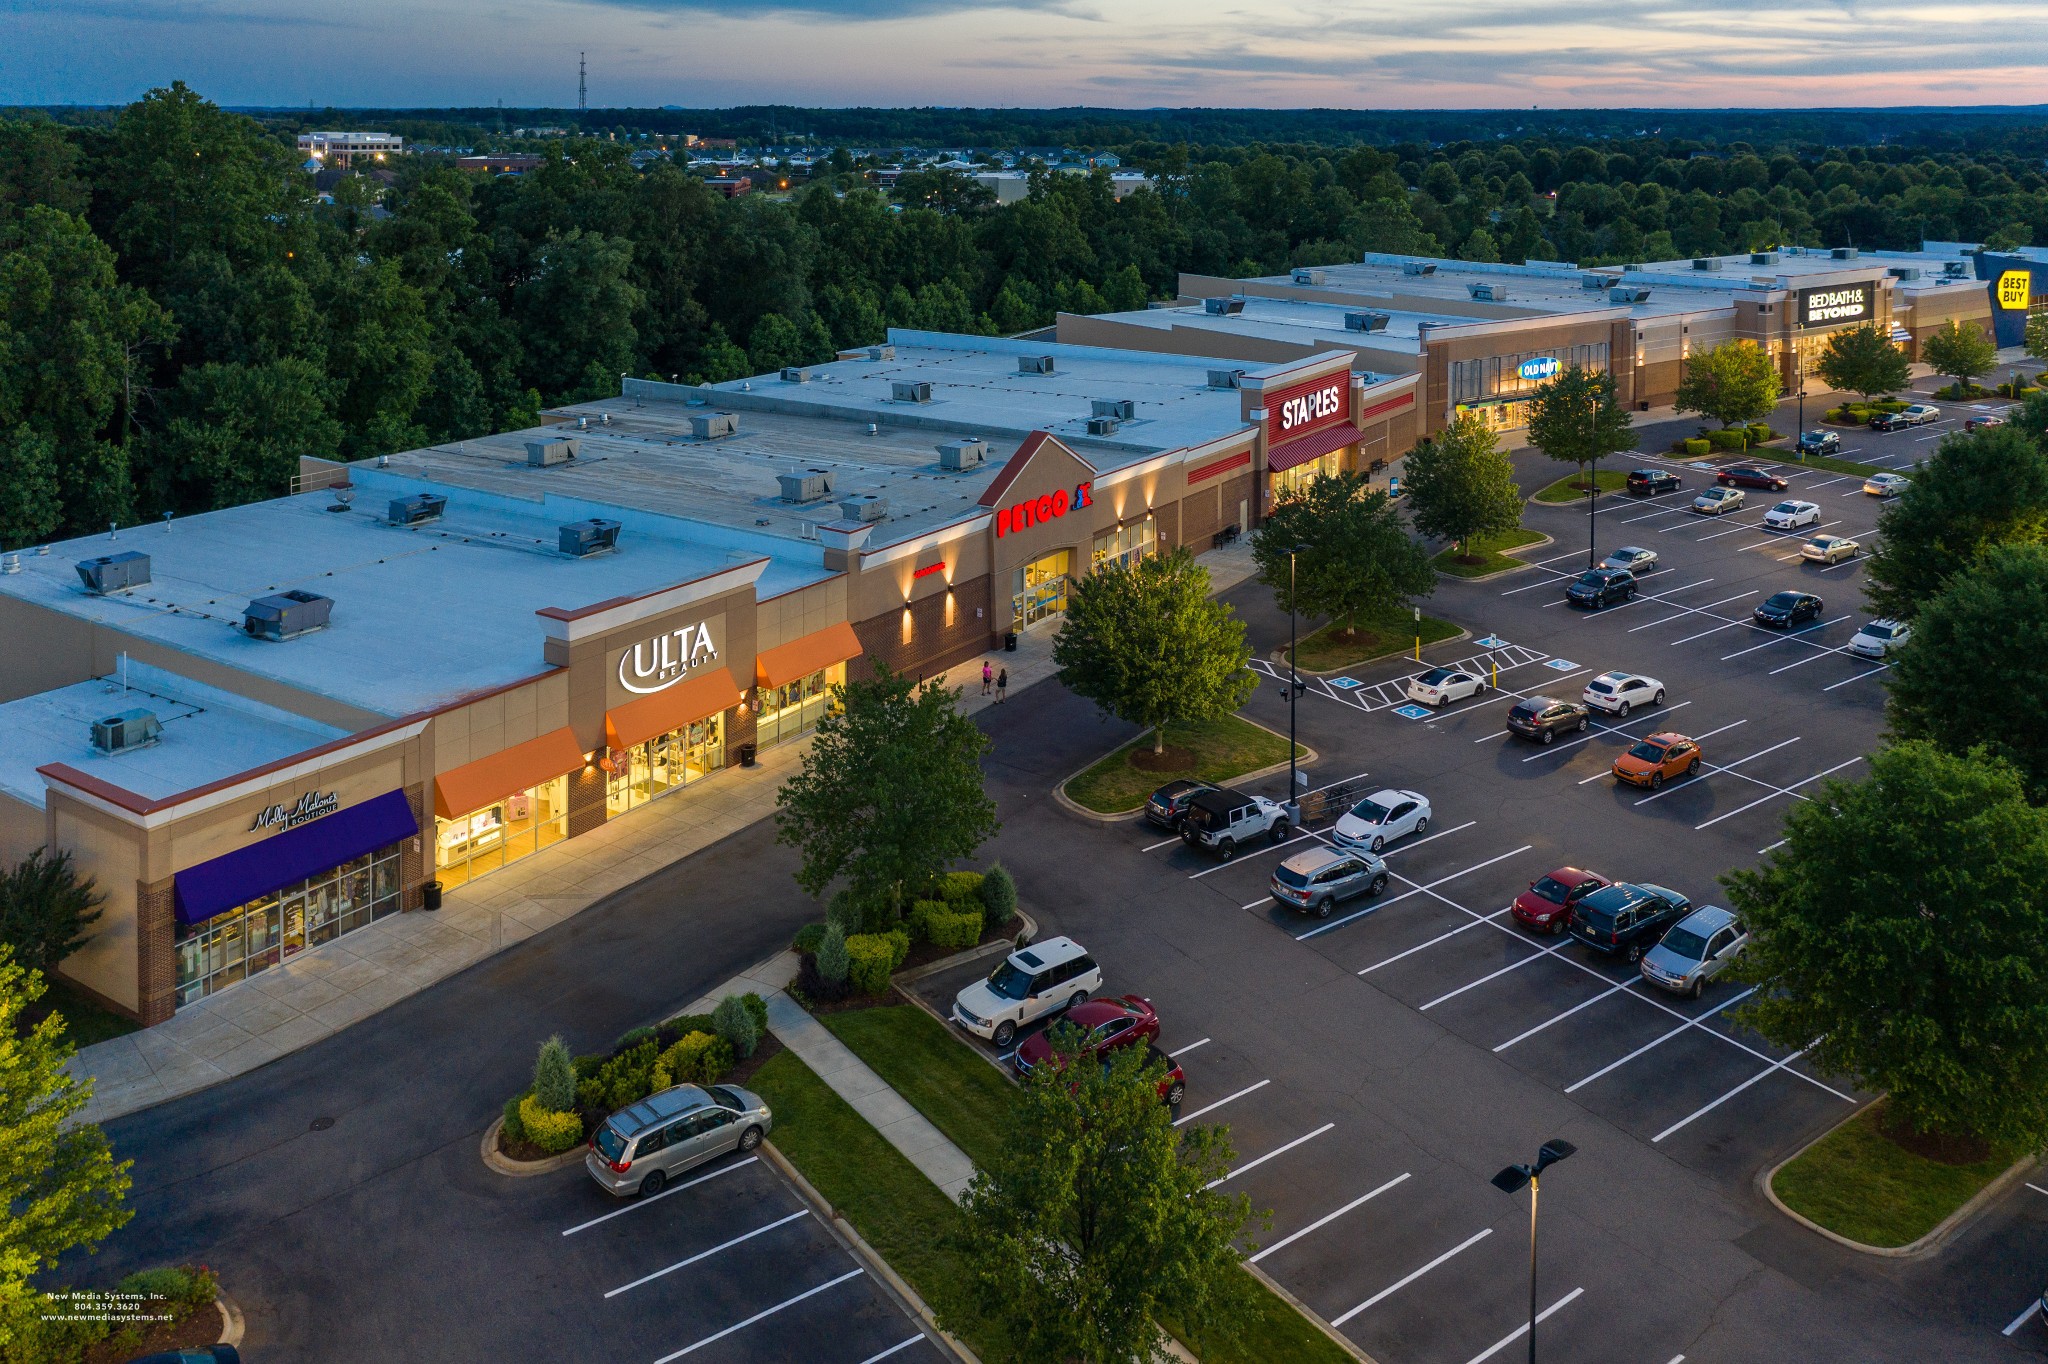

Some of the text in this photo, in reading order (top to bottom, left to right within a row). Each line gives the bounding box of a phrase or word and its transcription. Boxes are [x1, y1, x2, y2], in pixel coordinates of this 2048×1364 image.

[2003, 278, 2027, 289] BEST
[1809, 289, 1864, 309] BED BATH &
[2003, 291, 2024, 302] BUY
[1809, 304, 1864, 322] BEYOND
[1524, 362, 1557, 376] OLD NAVY
[1283, 386, 1339, 430] STAPLES
[997, 489, 1069, 539] PETCO
[634, 621, 715, 678] ULTA
[659, 651, 718, 680] BEAUTY
[249, 806, 288, 833] Molly
[291, 803, 337, 826] BOUTIQUE
